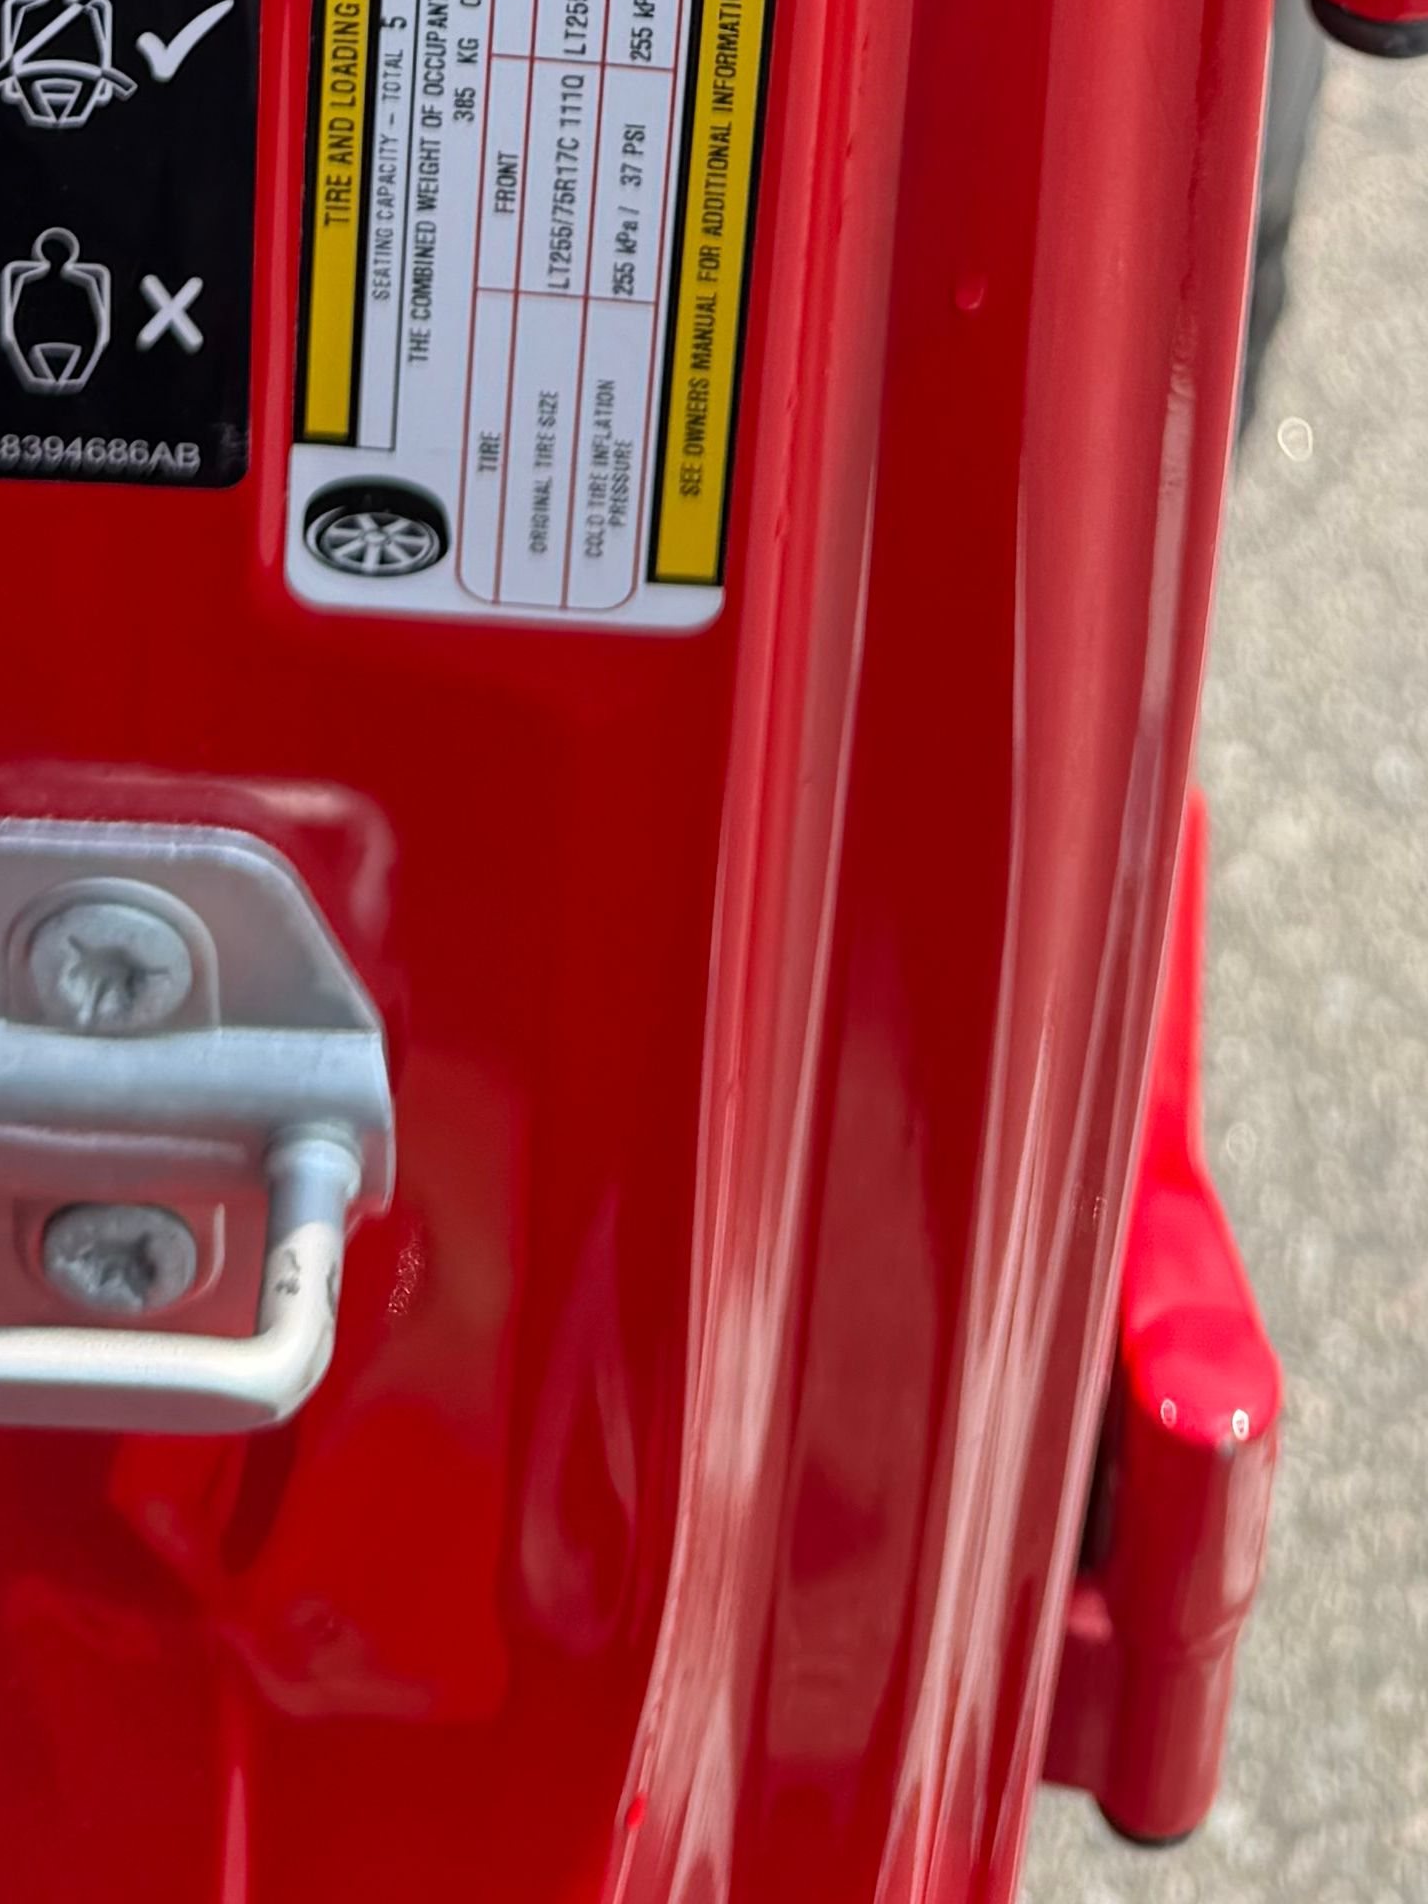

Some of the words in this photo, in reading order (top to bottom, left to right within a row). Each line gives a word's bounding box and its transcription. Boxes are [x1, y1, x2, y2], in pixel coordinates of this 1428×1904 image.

[380, 16, 405, 31] 5
[630, 27, 653, 62] 255
[330, 3, 360, 107] LOADING
[457, 38, 479, 64] KG
[382, 49, 403, 101] TOTAL
[421, 105, 442, 128] OF
[453, 87, 476, 123] 385
[559, 75, 584, 128] 111Q
[328, 117, 354, 165] AND
[622, 124, 646, 155] PSI
[377, 134, 398, 220] CAPACITY
[416, 137, 441, 211] WEIGHT
[494, 150, 518, 214] FRONT
[620, 163, 642, 187] 37
[702, 122, 732, 237] ADDITIONAL
[324, 175, 352, 227] TIRE
[548, 137, 579, 289] LT255/75R17C
[615, 221, 638, 254] kPa
[373, 228, 393, 300] SEATING
[411, 221, 436, 321] COMBINED
[612, 262, 635, 296] 255
[697, 245, 721, 282] FOR
[408, 329, 430, 362] THE
[690, 292, 717, 370] MANUAL
[683, 378, 709, 456] OWNERS
[478, 432, 499, 472] TIRE
[534, 432, 555, 467] TIRE
[680, 463, 702, 496] SEE
